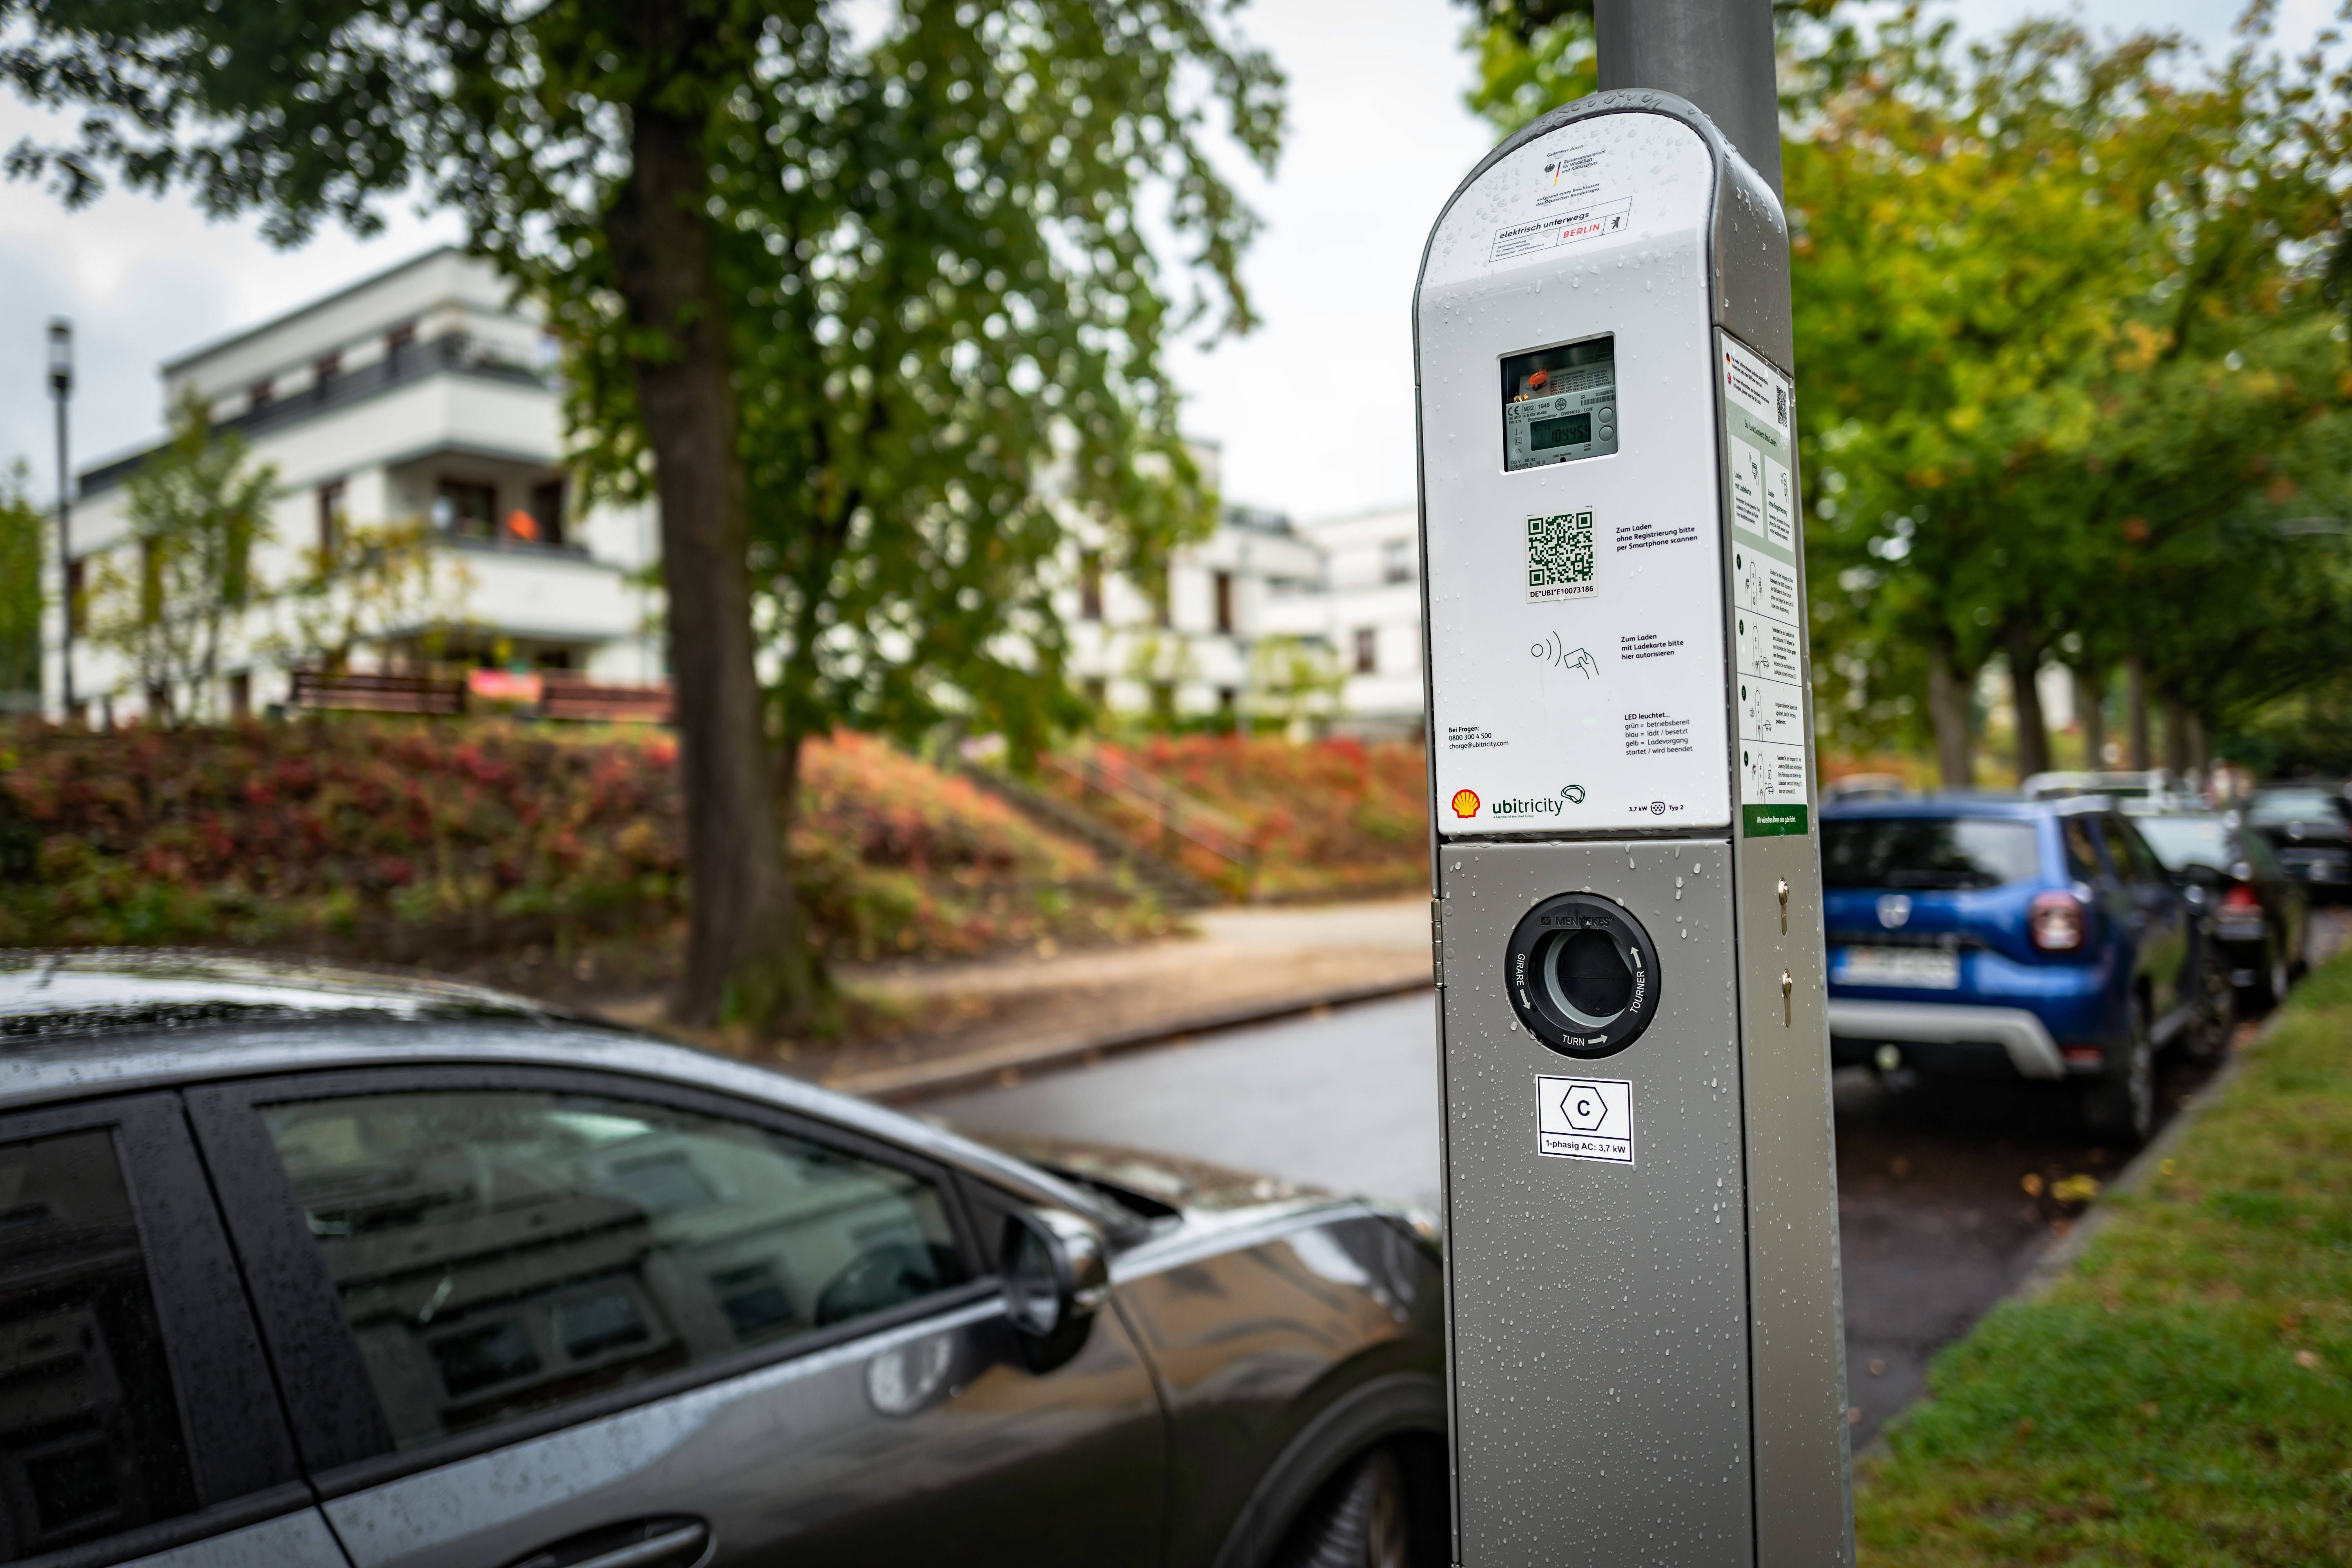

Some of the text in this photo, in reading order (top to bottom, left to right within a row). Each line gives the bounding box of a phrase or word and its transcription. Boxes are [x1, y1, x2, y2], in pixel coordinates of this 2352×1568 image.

[1564, 150, 1606, 164] Bundesministerium
[1570, 158, 1592, 167] Wirtschaft
[1572, 162, 1598, 171] Klimaschutz
[1537, 193, 1559, 201] aufgrund
[1572, 183, 1599, 192] Beschlusses
[1544, 195, 1569, 204] Deutschen
[1570, 188, 1599, 197] Bundestages
[1500, 212, 1589, 239] elektrisch unterwegs
[1563, 223, 1600, 238] BERLIN
[1528, 414, 1557, 422] Einphasenzähler
[1744, 419, 1748, 429] So
[1748, 422, 1764, 439] funktioniert
[1740, 483, 1751, 496] Ladekarte
[1634, 529, 1677, 540] Registrierung
[1629, 539, 1668, 549] Smartphone
[1449, 741, 1508, 750] charge@ubitricity.com
[1493, 798, 1563, 816] ubitricity
[1516, 953, 1525, 986] GIRARE
[1630, 971, 1644, 1013] TOURNER
[1563, 1034, 1584, 1046] TURN
[1577, 1100, 1590, 1116] C
[1546, 1140, 1579, 1150] 1-phasig
